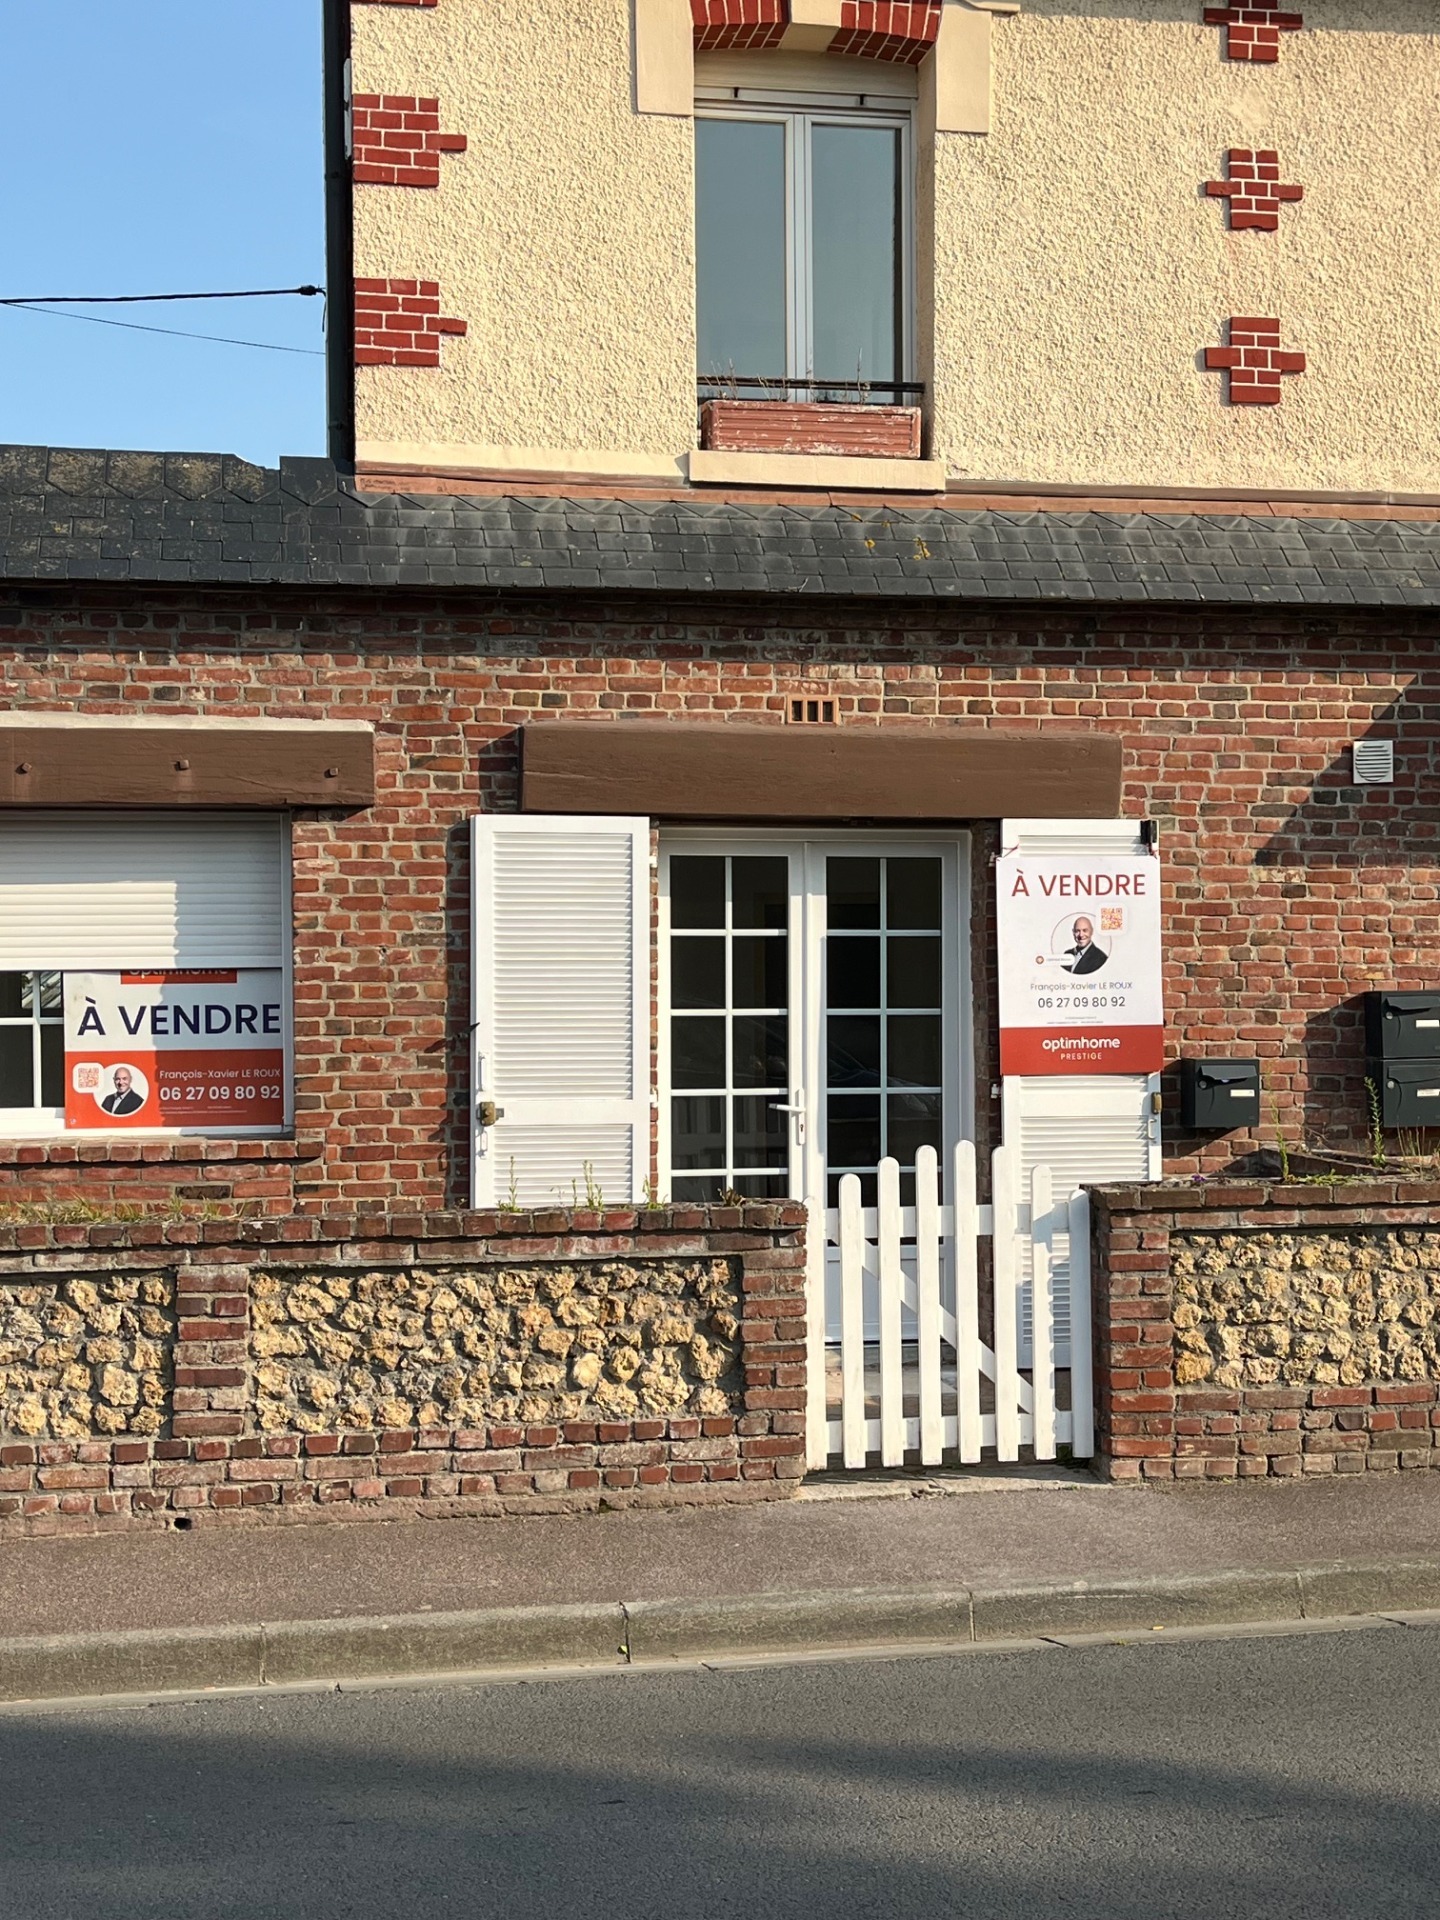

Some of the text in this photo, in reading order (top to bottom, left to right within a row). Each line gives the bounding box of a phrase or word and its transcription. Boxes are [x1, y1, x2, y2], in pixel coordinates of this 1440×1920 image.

[1011, 868, 1146, 897] À VENDRE
[1030, 983, 1097, 992] François-Xavier
[1099, 982, 1107, 990] LE
[1037, 996, 1126, 1008] 06 27 09 80 92
[77, 996, 281, 1035] À VENDRE
[1042, 1036, 1121, 1052] optimhome
[1060, 1052, 1102, 1060] PRESTIGE
[159, 1069, 281, 1081] François-Xavier LE ROUX
[159, 1086, 281, 1100] 06 27 09 80 92
